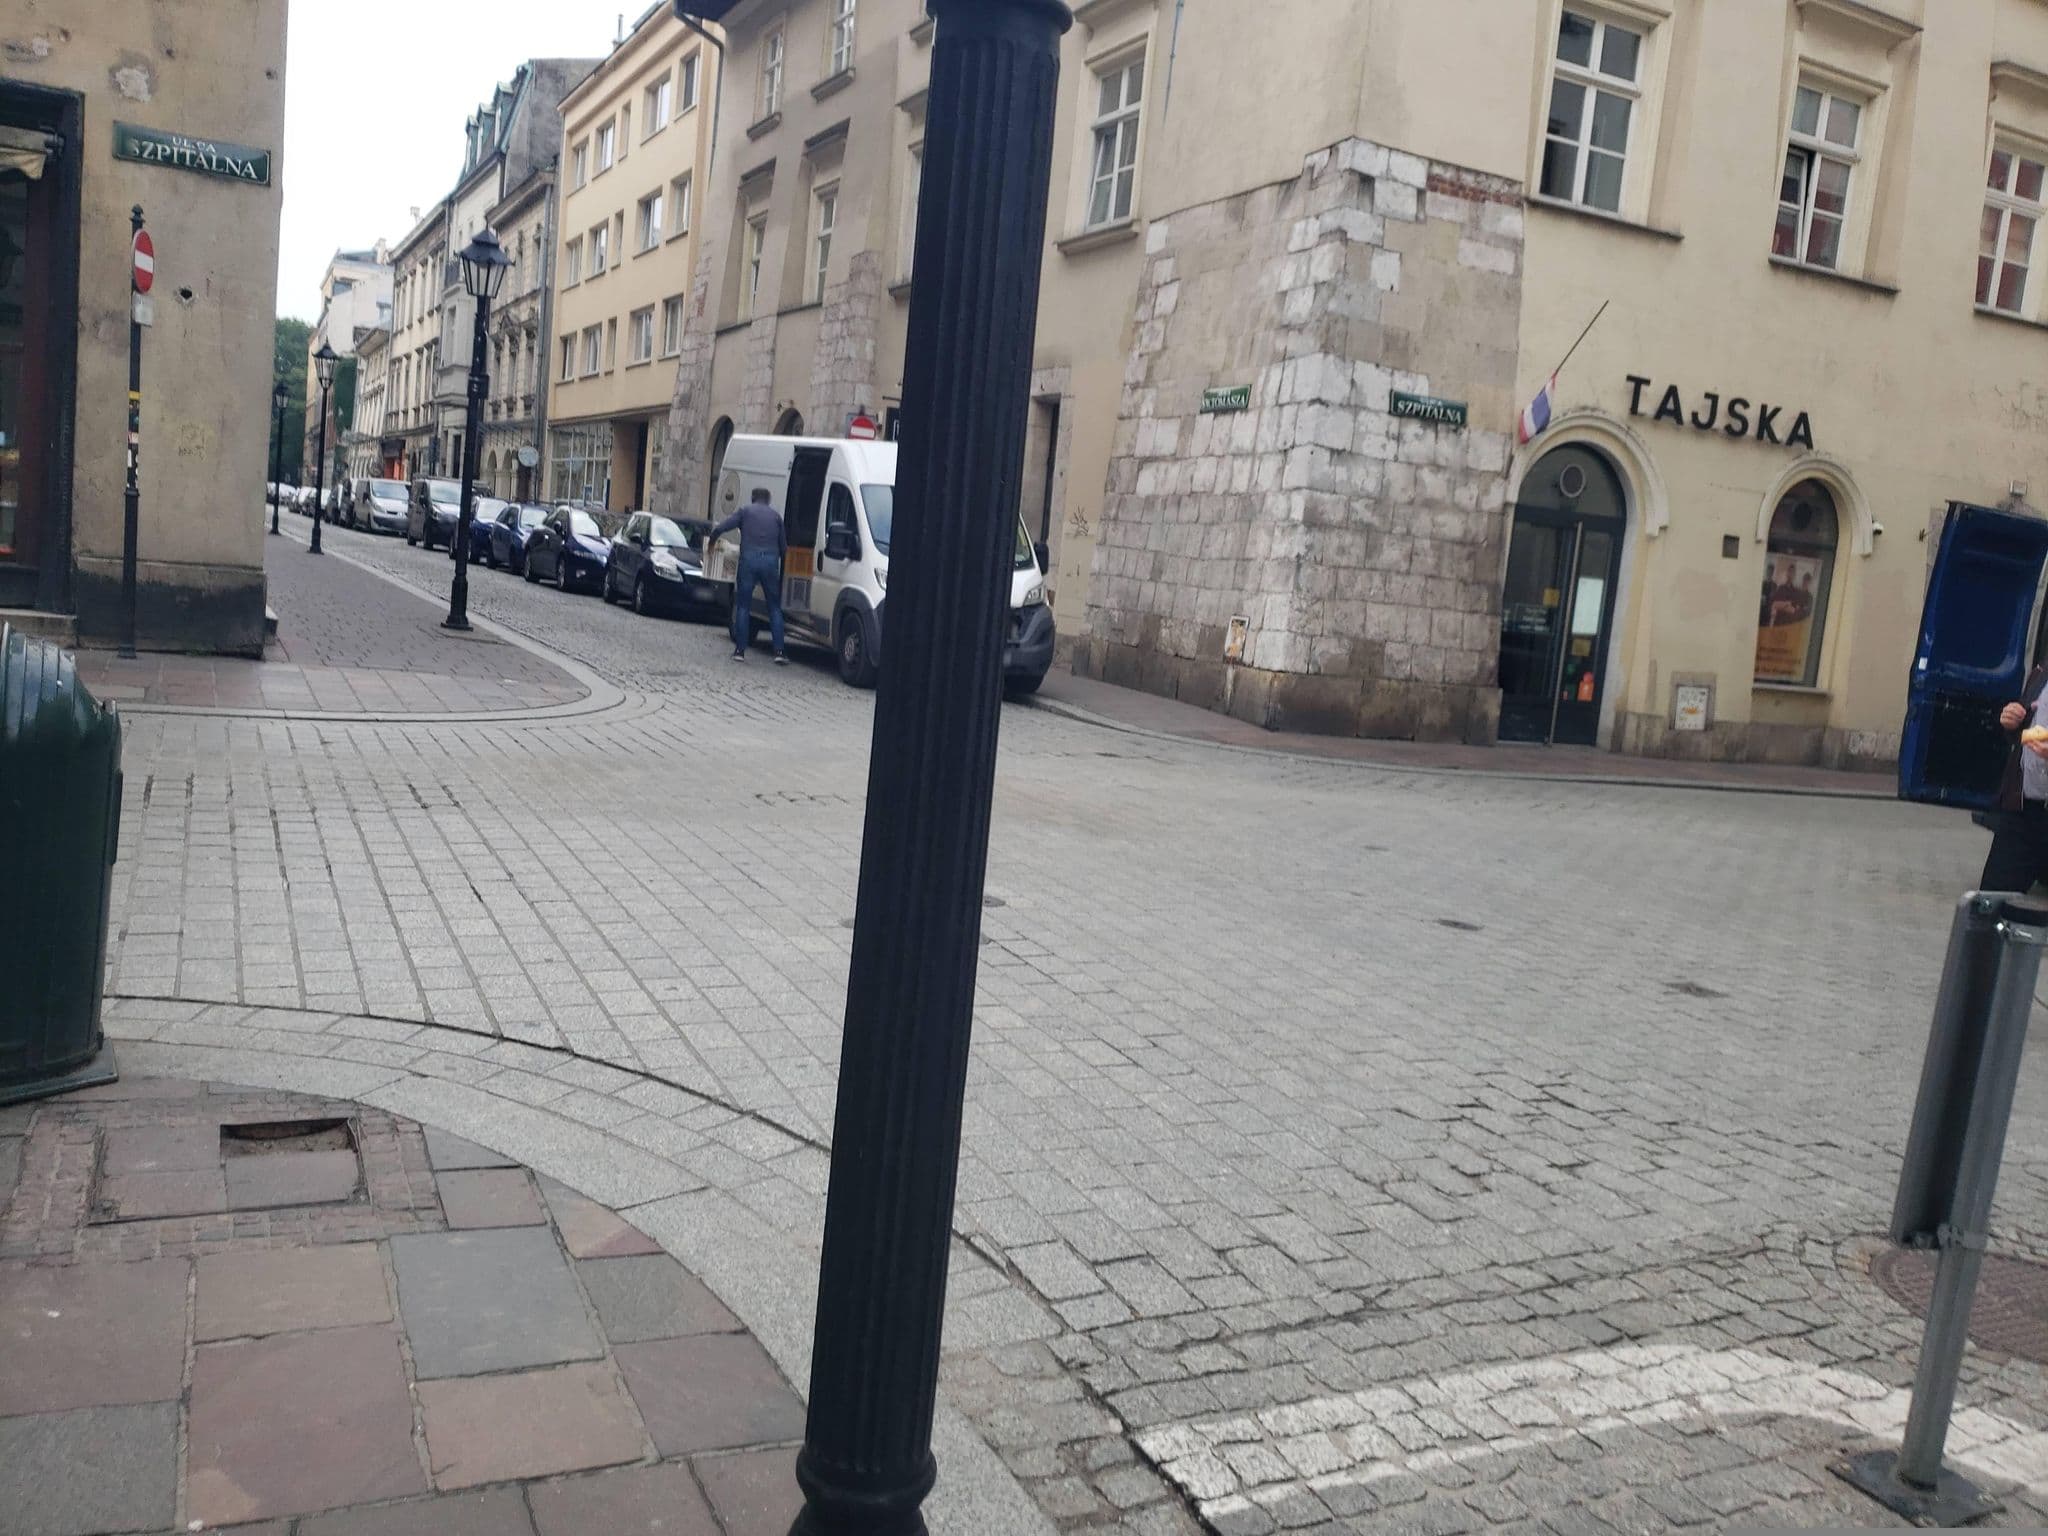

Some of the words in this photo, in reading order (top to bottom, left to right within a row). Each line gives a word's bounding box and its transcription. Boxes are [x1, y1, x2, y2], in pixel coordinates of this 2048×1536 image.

[127, 138, 258, 179] SZPITALNA
[172, 136, 216, 152] ULCA
[1397, 400, 1461, 424] SZPITALNA
[1626, 374, 1814, 450] TAJSKA
